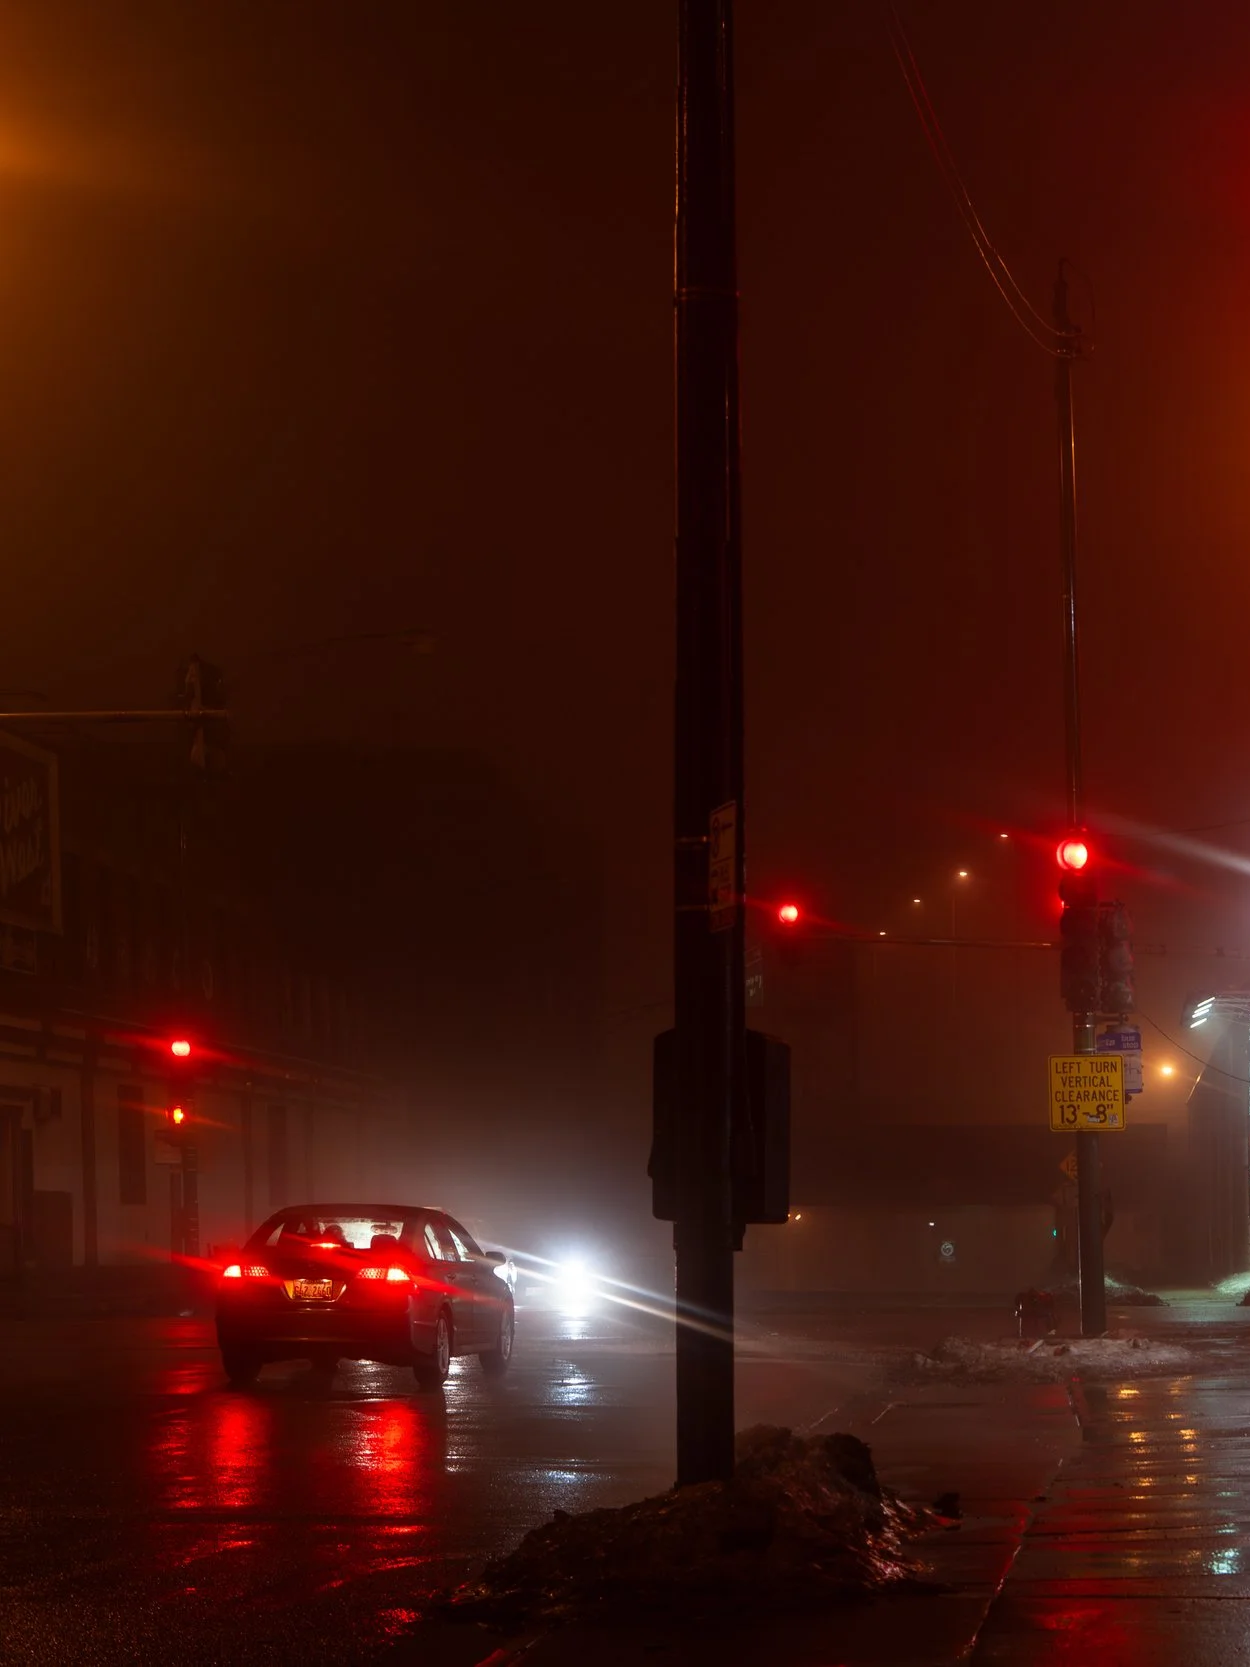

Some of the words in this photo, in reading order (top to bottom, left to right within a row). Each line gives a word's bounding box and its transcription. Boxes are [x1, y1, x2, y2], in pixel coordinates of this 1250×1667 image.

[1055, 1061, 1081, 1074] LEFT
[1090, 1061, 1118, 1074] TURN
[1061, 1075, 1113, 1088] VERTICAL
[1054, 1089, 1120, 1102] CLEARANCE
